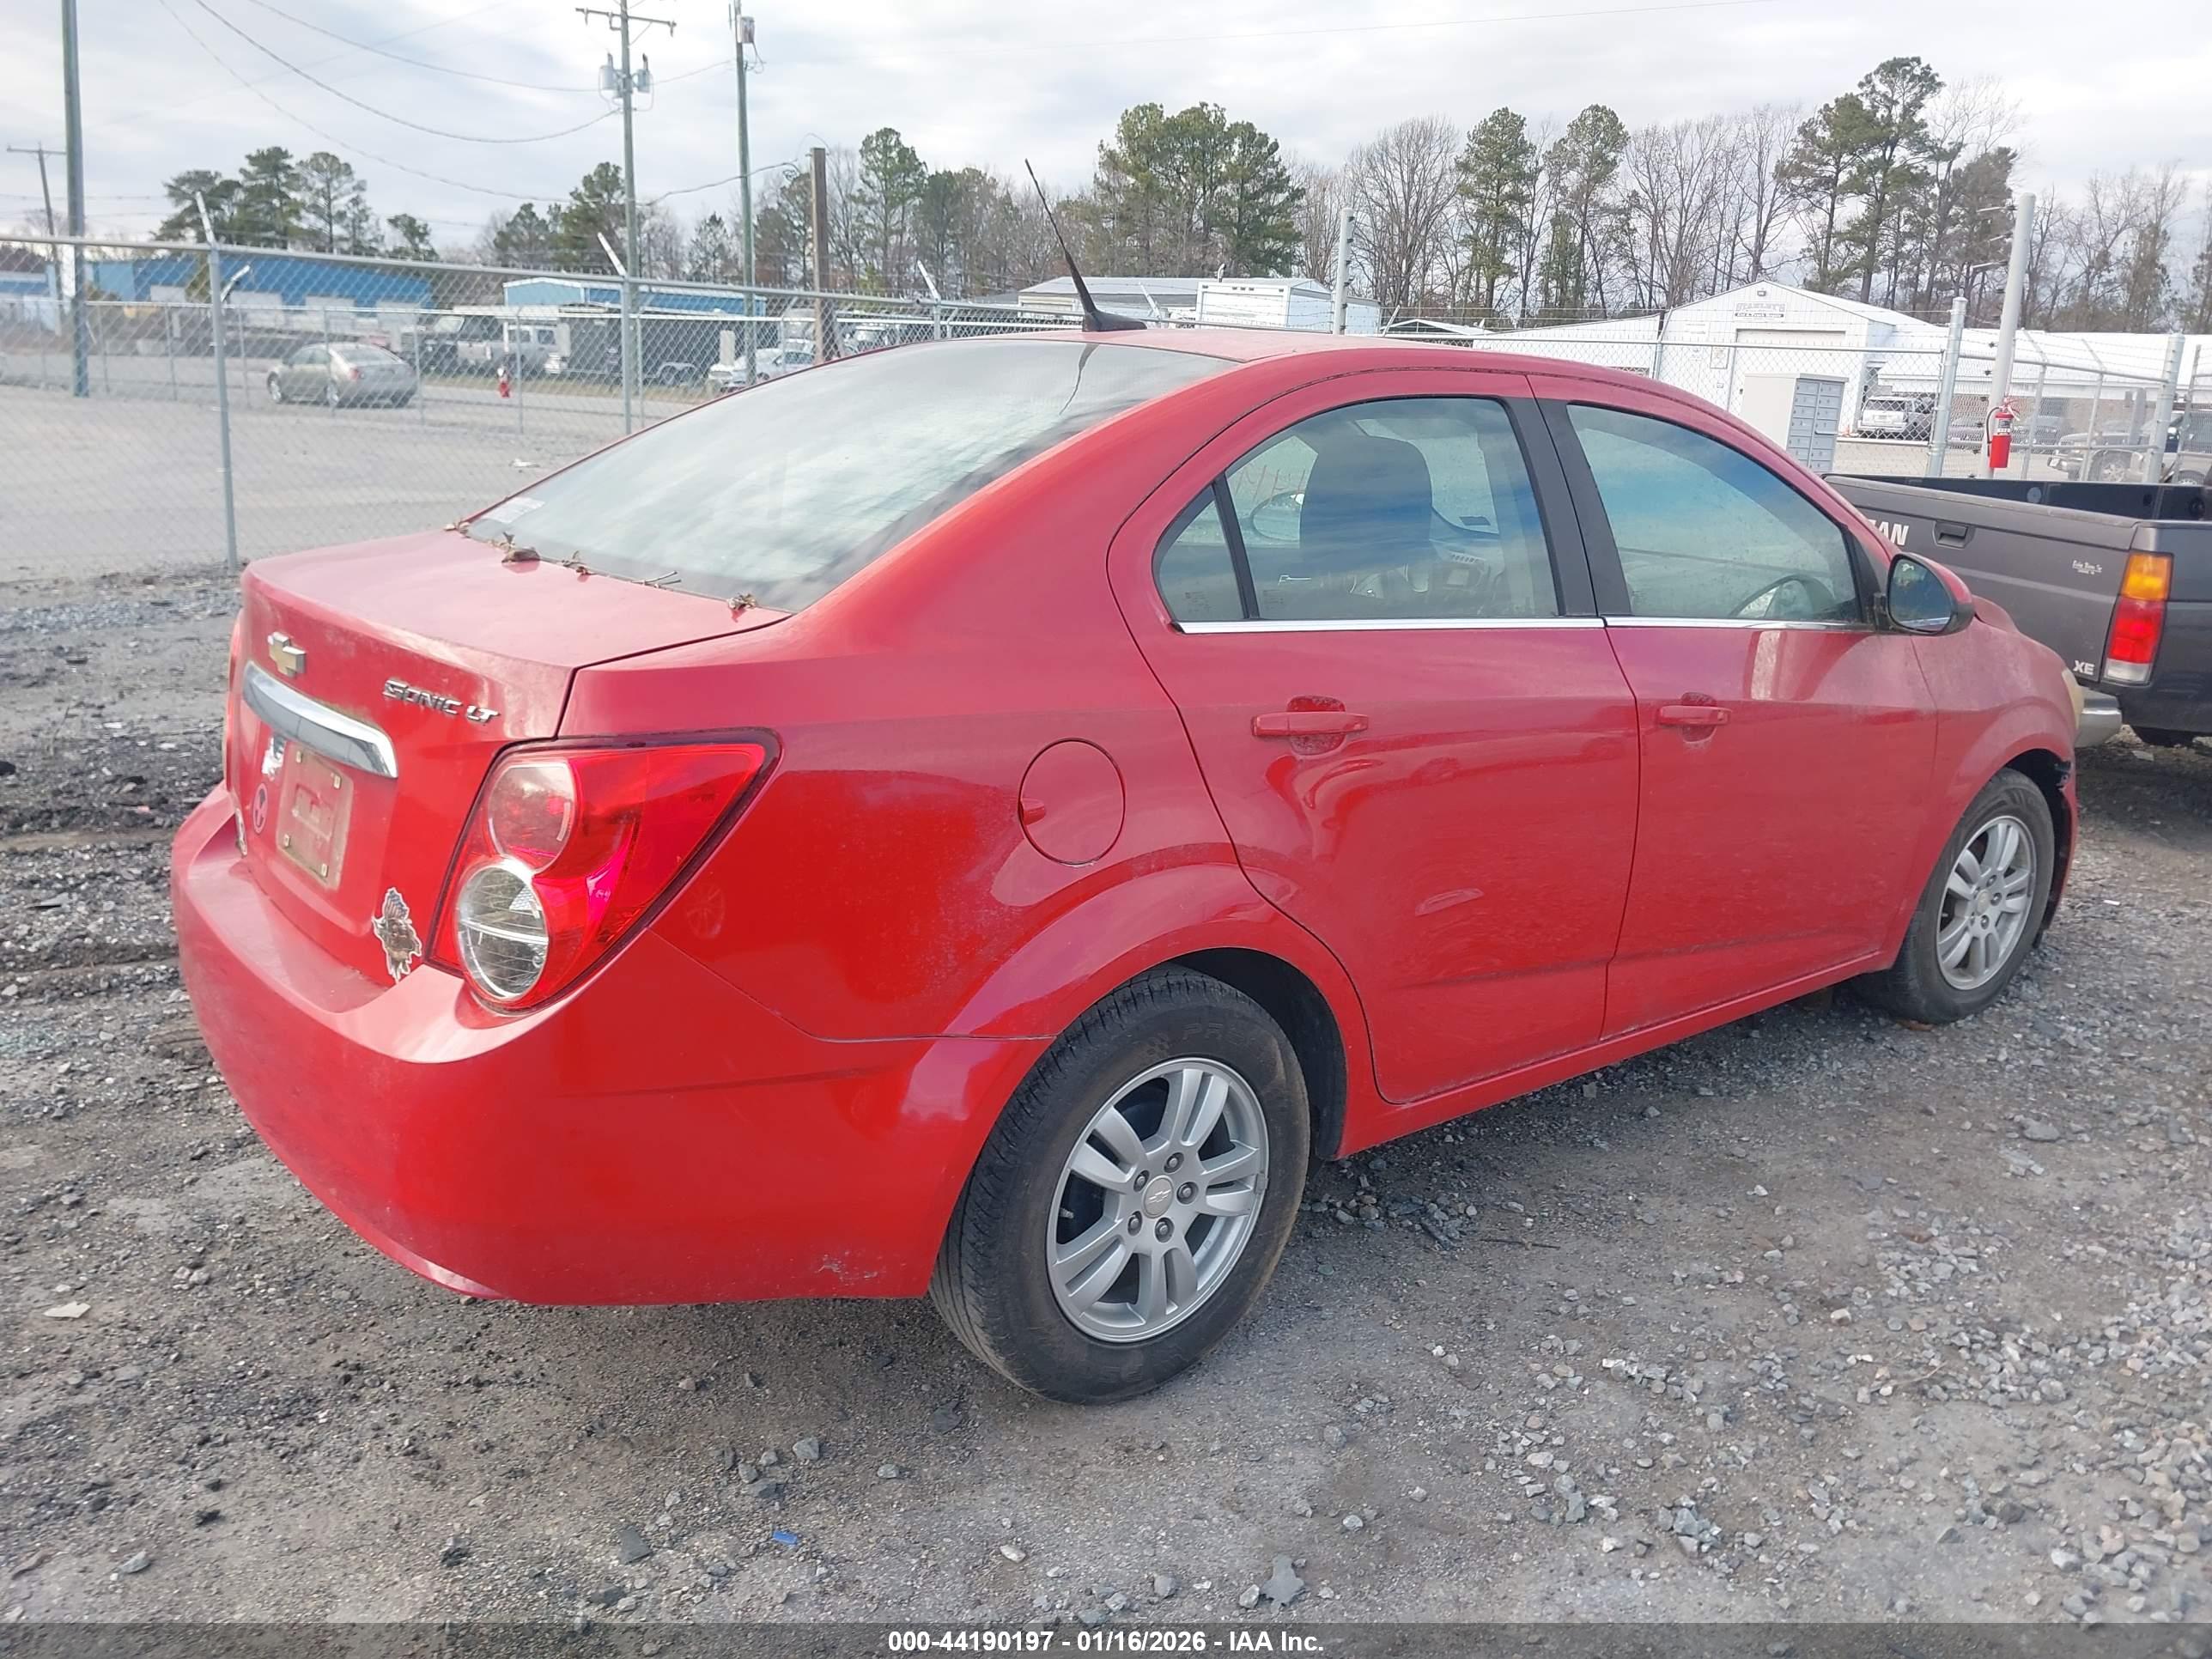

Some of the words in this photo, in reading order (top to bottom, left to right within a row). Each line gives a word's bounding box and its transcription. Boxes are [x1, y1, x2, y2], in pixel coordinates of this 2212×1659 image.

[1868, 519, 1910, 546] AN
[2072, 659, 2095, 676] XE
[382, 678, 463, 714] SONIC
[466, 704, 500, 723] LT
